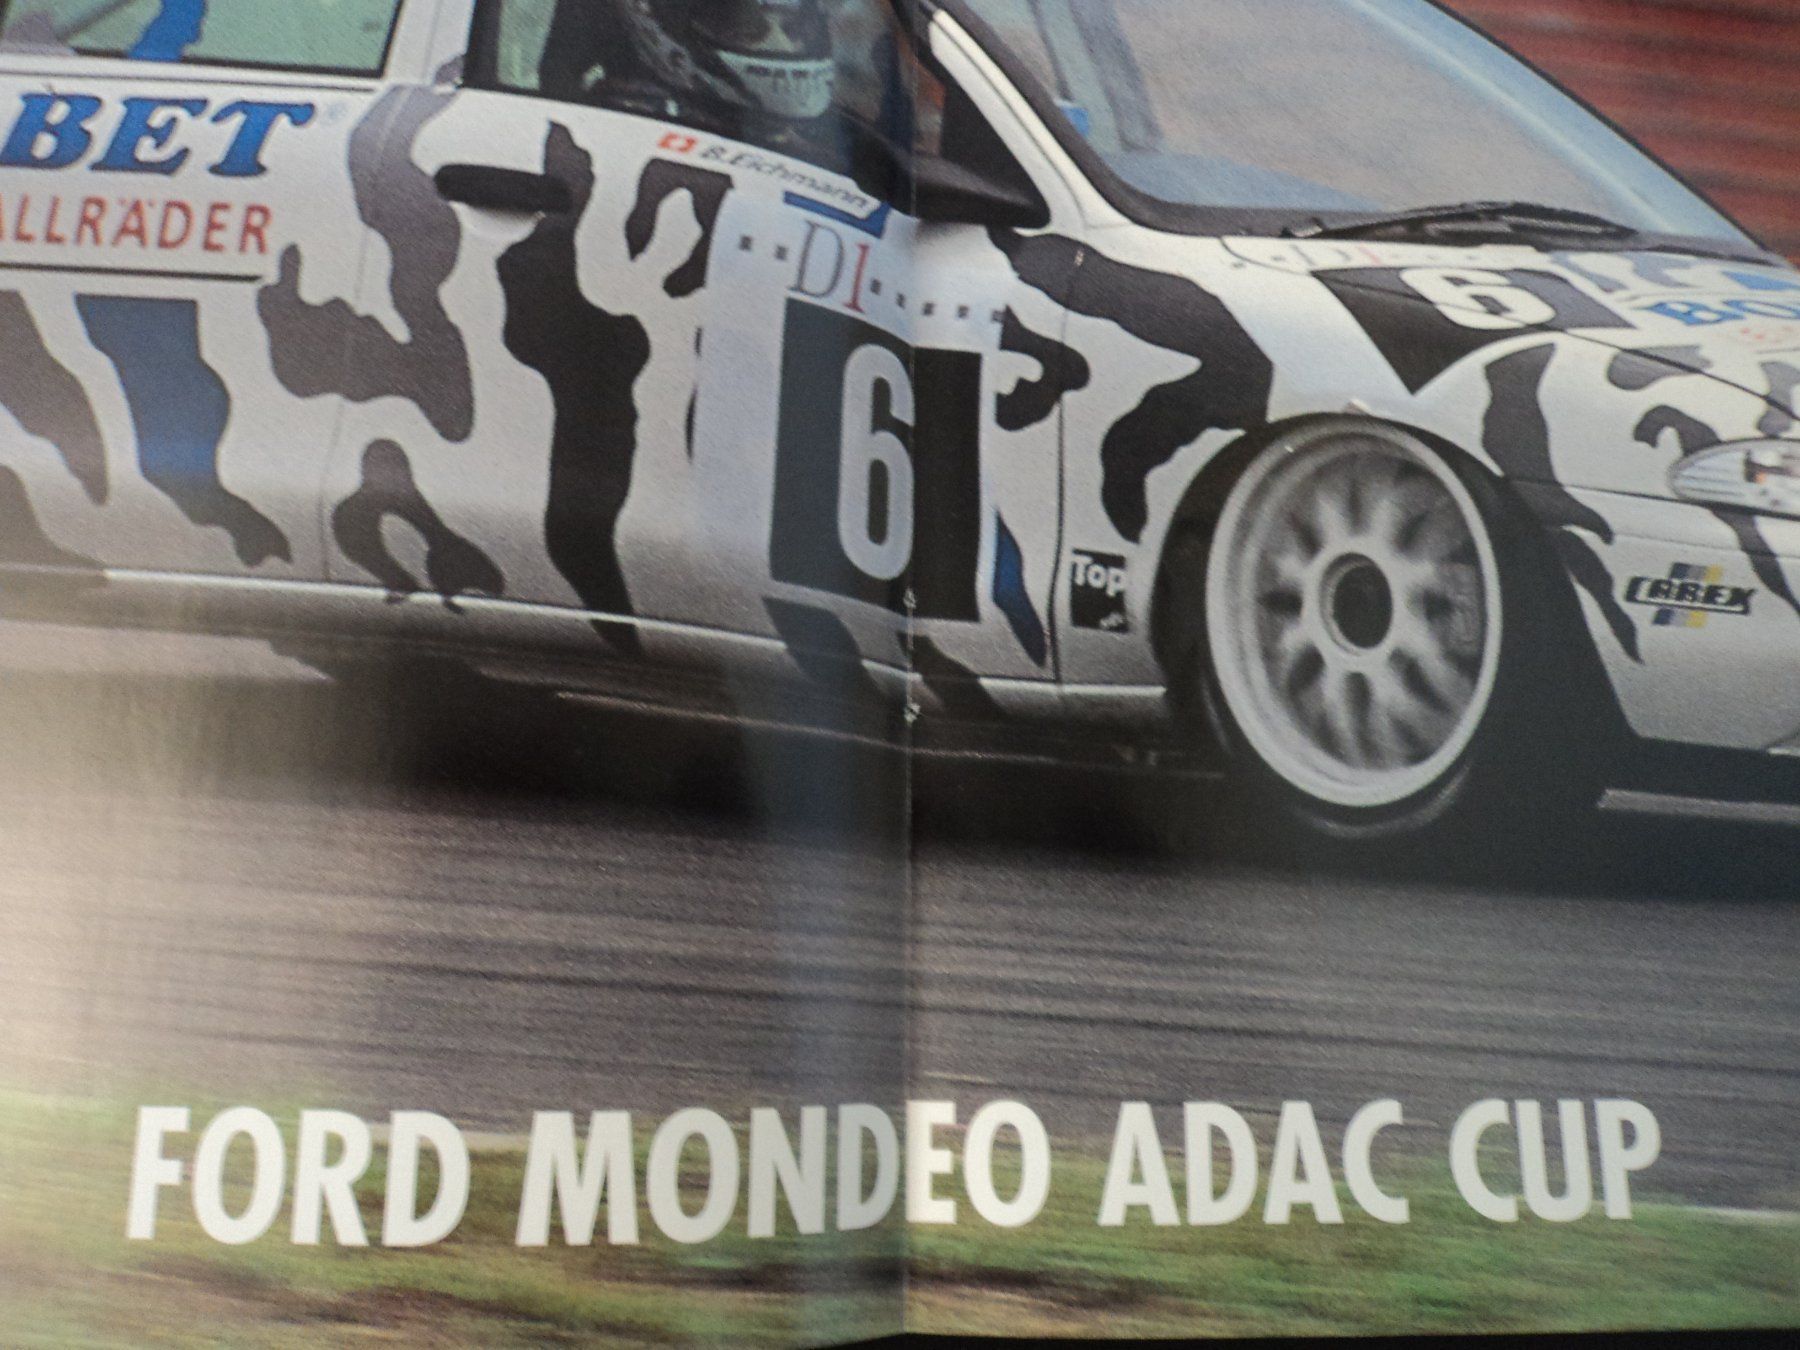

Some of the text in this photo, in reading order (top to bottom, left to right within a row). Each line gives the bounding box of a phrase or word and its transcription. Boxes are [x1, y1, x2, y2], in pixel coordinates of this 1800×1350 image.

[0, 192, 273, 254] LLRÄDER
[1399, 267, 1556, 330] 6
[837, 342, 916, 581] 6
[1071, 553, 1126, 598] Top
[126, 1098, 1663, 1248] FORD MONDEO ADAC CUP
